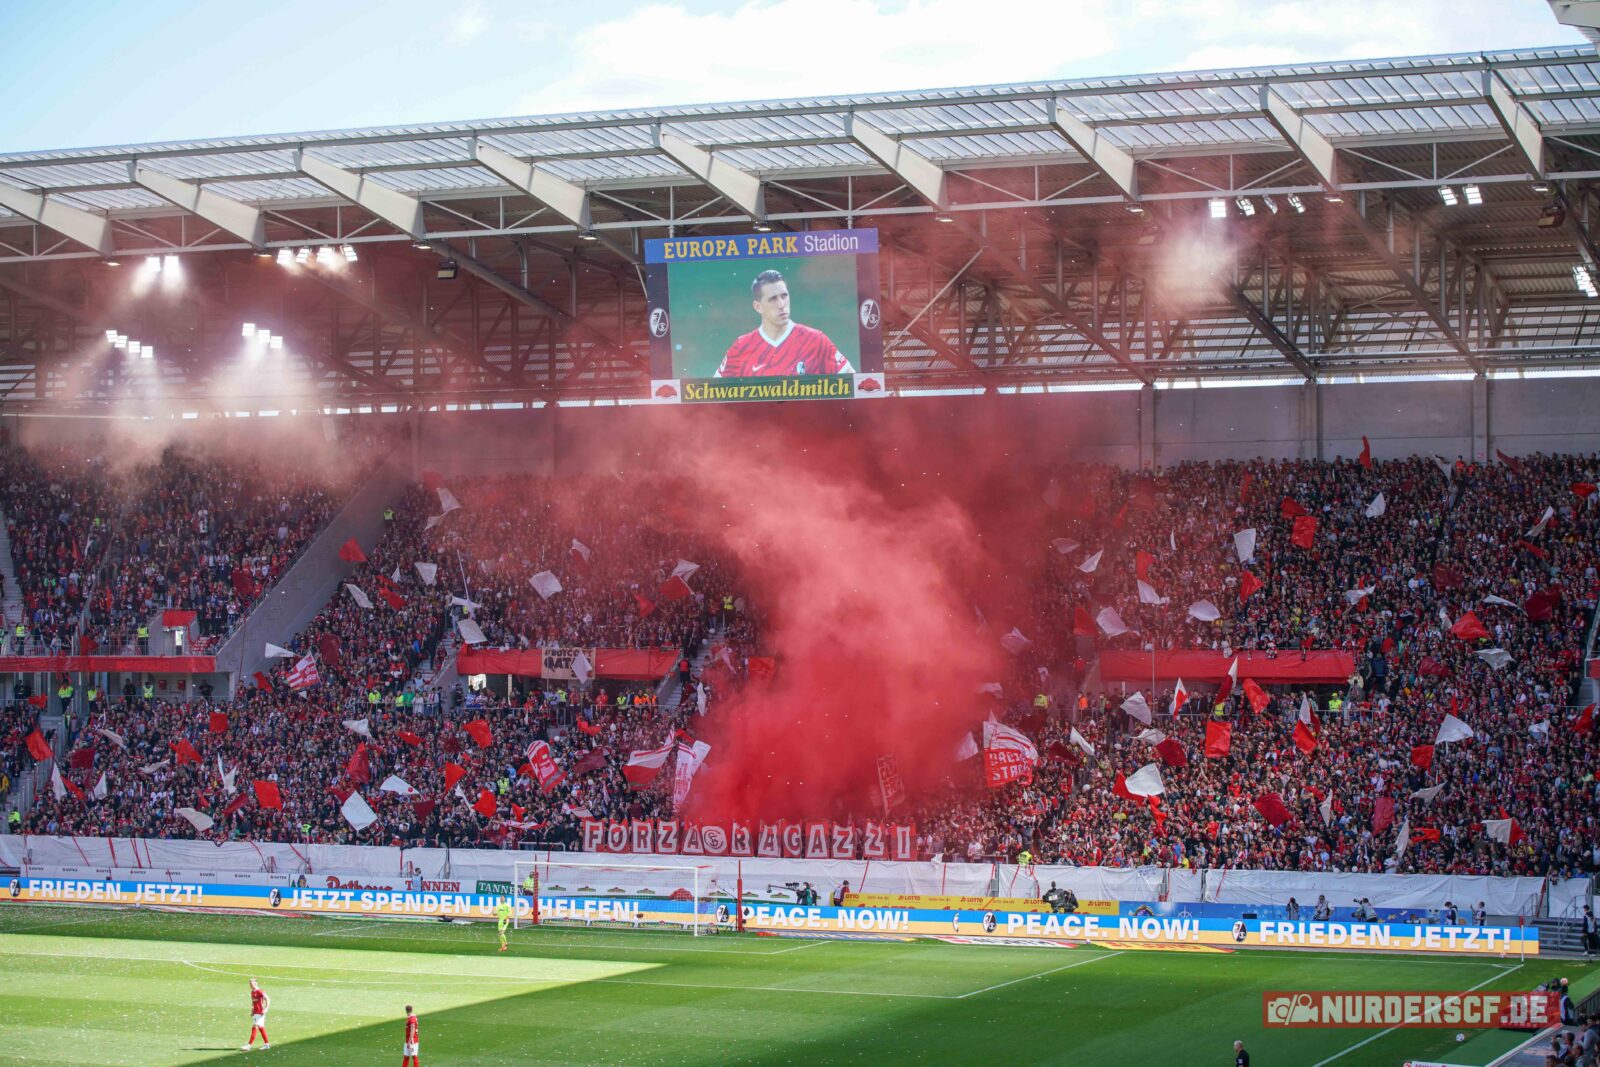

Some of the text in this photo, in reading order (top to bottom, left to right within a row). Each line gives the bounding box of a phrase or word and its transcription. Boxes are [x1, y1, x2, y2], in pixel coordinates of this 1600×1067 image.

[664, 235, 859, 259] EUROPA PARK Stadion
[685, 378, 850, 400] Schwarzwaldmilch
[585, 820, 910, 858] FORZA RAGAZZI
[29, 880, 203, 904] FRIEDEN. JETZT!
[405, 880, 460, 892] TNNEN
[290, 890, 355, 909] JETZT
[359, 892, 471, 915] SPENDEN
[741, 906, 909, 931] PEACE. NOW!
[1007, 913, 1199, 941] PEACE. NOW!
[1259, 921, 1511, 950] FRIEDEN. JETZT!
